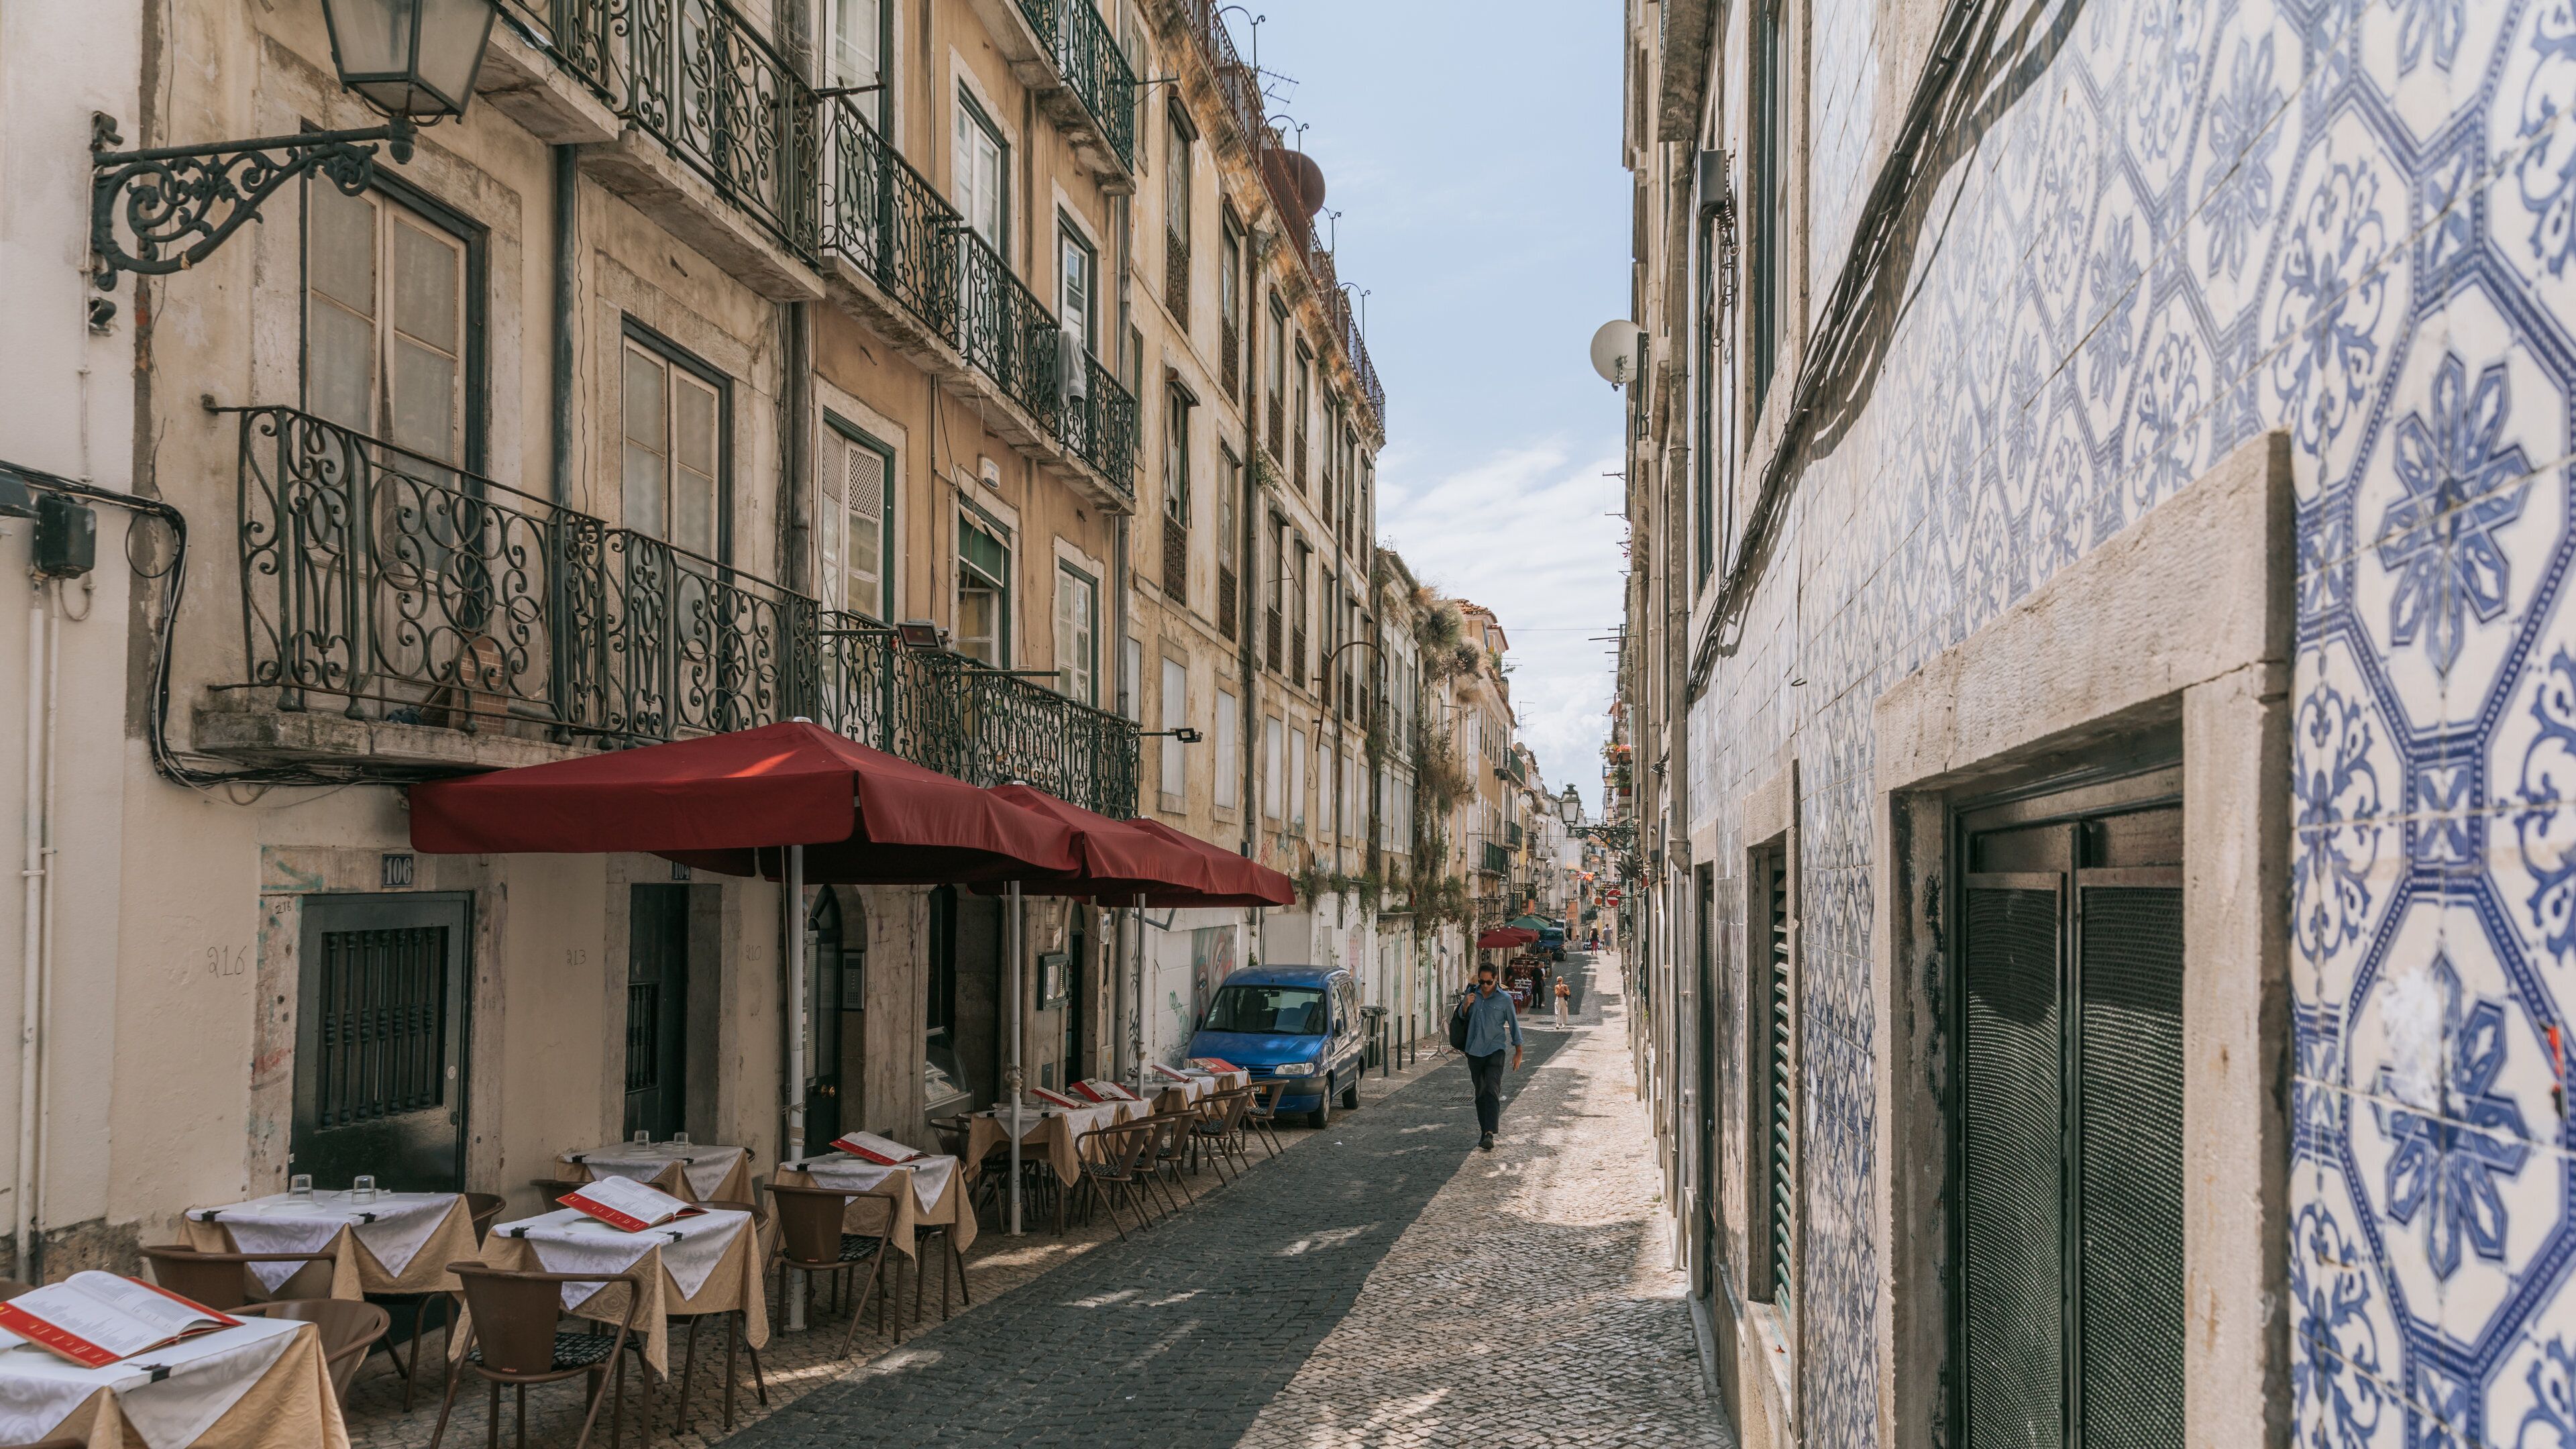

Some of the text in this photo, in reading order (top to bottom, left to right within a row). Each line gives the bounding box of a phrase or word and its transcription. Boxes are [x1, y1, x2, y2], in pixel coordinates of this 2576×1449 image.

[386, 858, 412, 883] 106
[674, 862, 690, 879] 104
[275, 901, 292, 914] 216
[567, 949, 586, 966] 213
[745, 944, 762, 961] 210
[207, 945, 247, 978] 216
